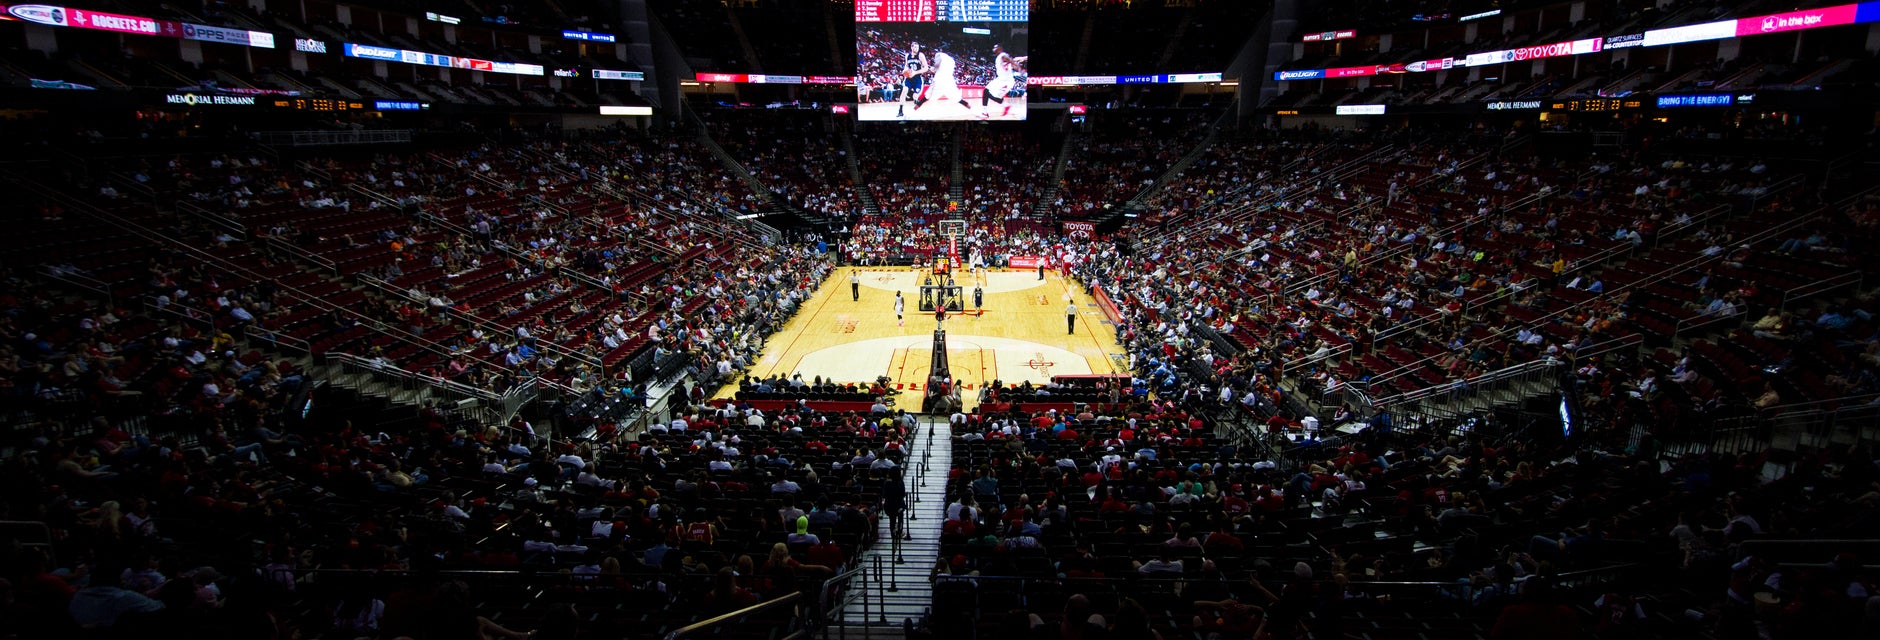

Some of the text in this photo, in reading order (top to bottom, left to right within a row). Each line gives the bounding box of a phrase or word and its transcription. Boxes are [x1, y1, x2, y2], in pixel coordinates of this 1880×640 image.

[91, 14, 161, 33] ROCKETS.COM
[1779, 18, 1787, 27] in
[1788, 17, 1803, 27] the
[1804, 15, 1822, 25] box
[197, 28, 225, 40] PPS
[1528, 42, 1572, 57] TOYOTA
[554, 69, 572, 77] reliant
[167, 93, 255, 106] MEMORIAL HERMANN
[1571, 101, 1579, 110] 37
[1610, 100, 1620, 110] 23
[1658, 97, 1680, 105] BRING
[1681, 96, 1695, 104] THE
[1487, 101, 1541, 110] MEMORIAL HERMANN
[1065, 223, 1094, 231] TOYOTA
